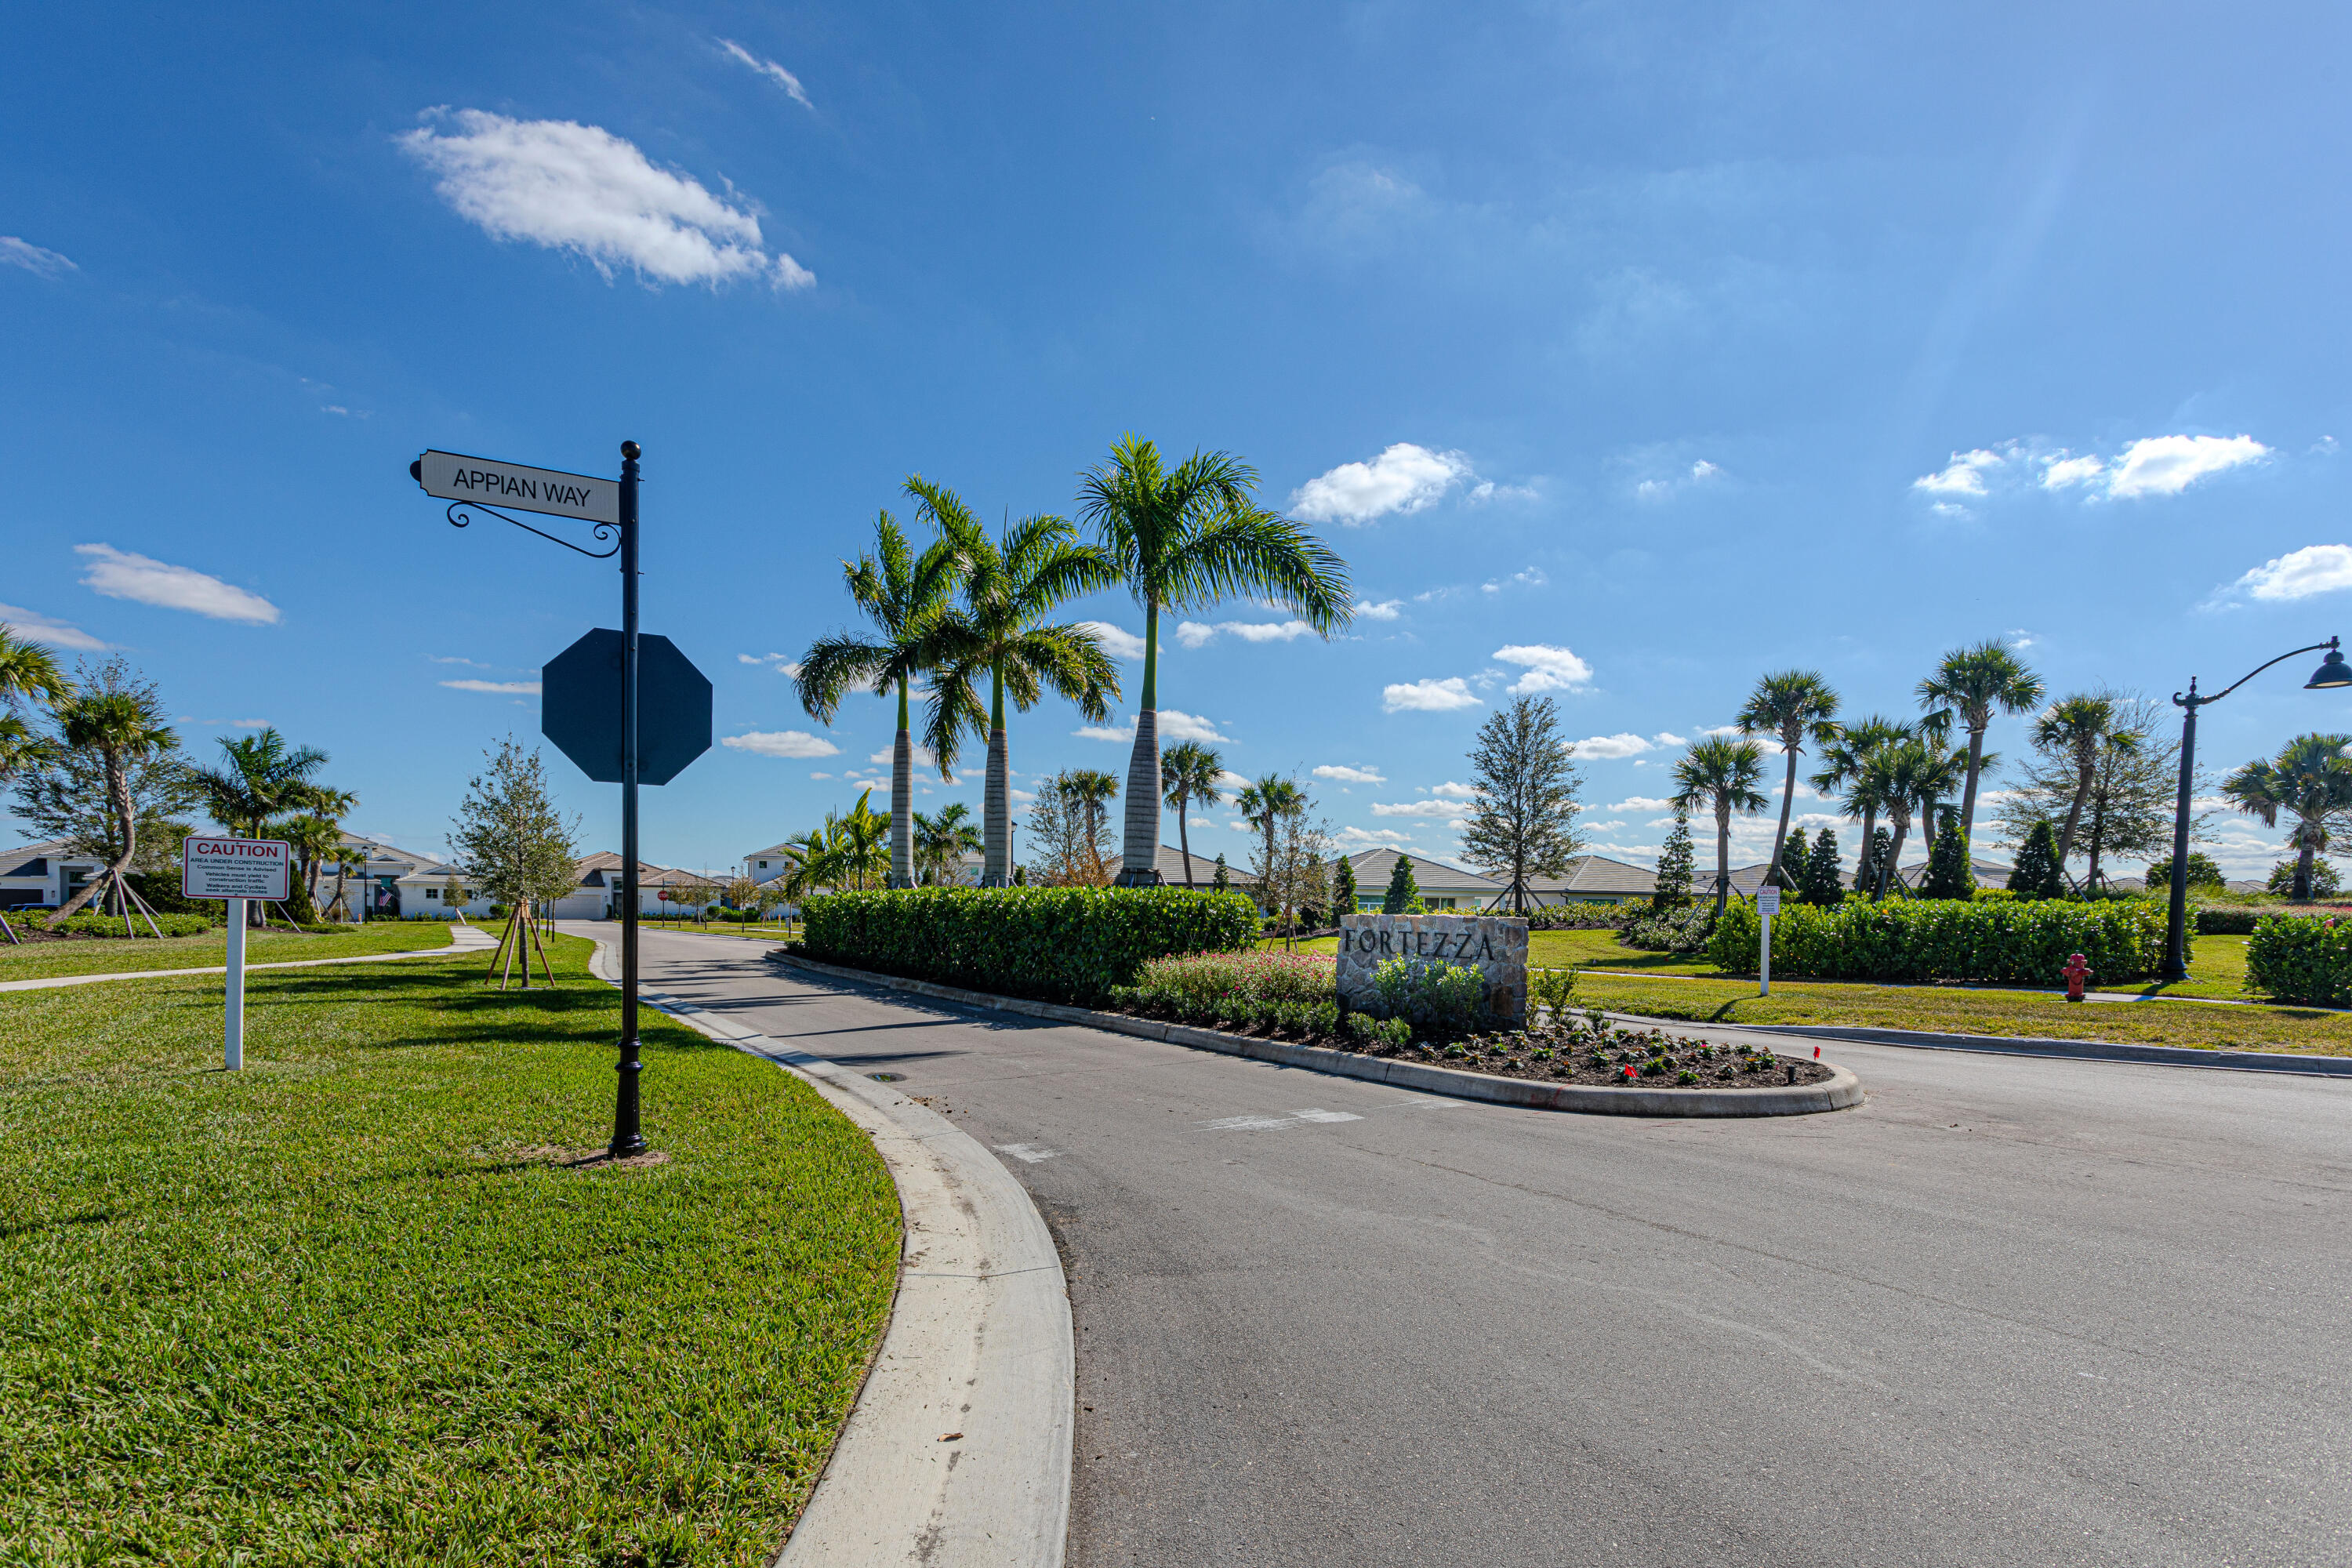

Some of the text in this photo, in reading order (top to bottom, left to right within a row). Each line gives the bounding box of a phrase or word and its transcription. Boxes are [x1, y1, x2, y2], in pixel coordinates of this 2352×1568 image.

[453, 469, 590, 506] APPIAN WAY
[197, 843, 278, 857] CAUTION
[1345, 929, 1494, 961] FORTEZZA
